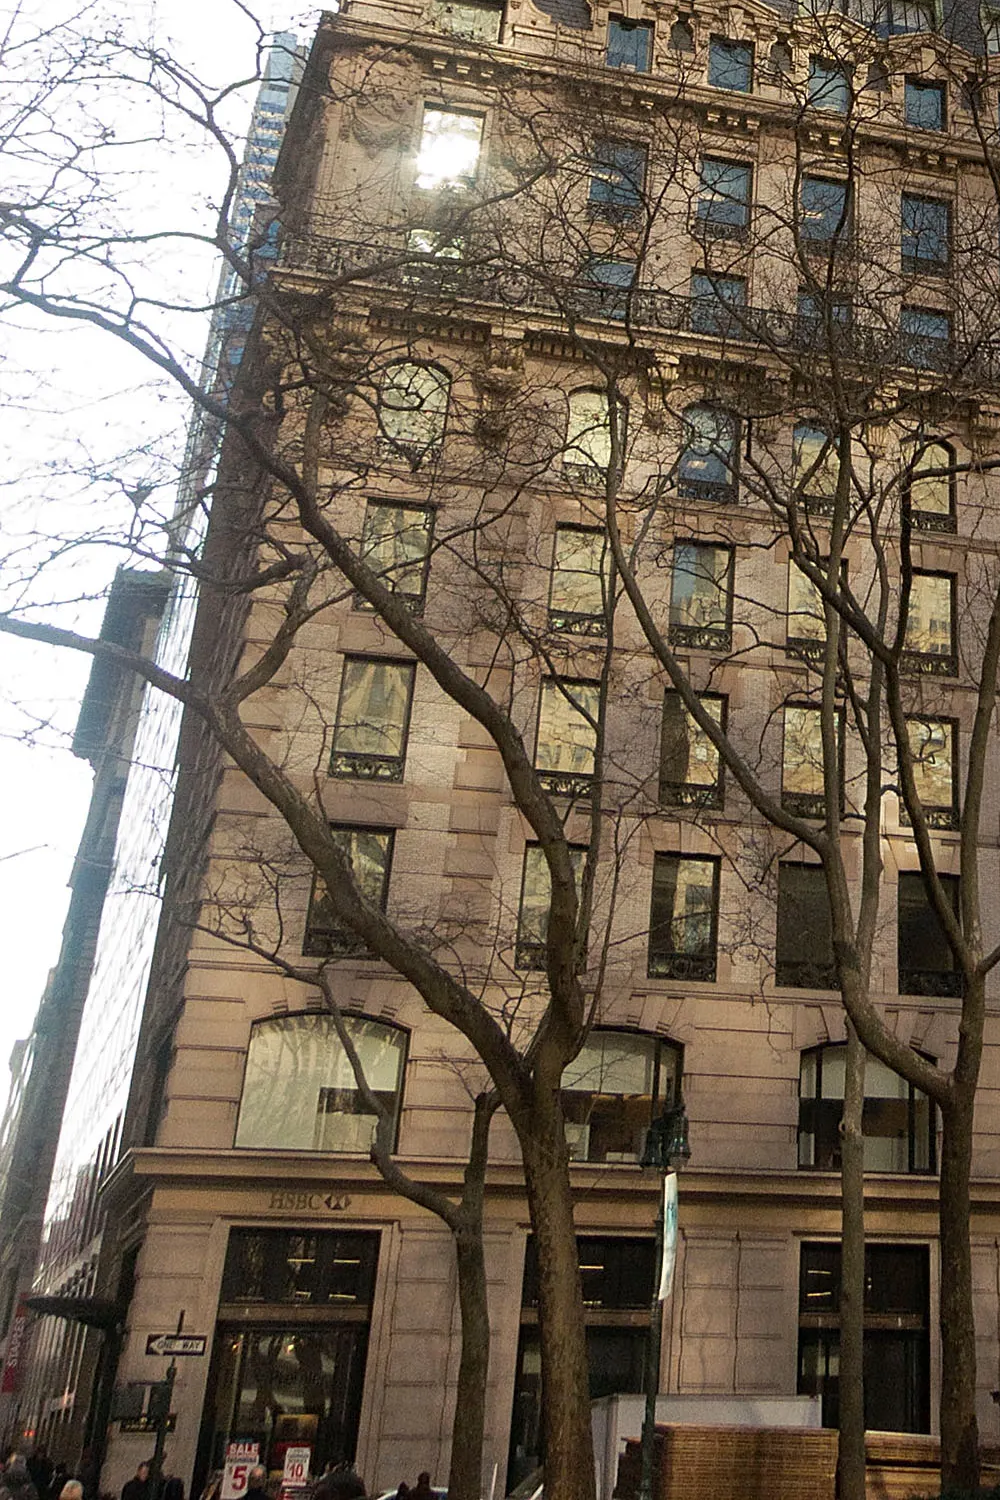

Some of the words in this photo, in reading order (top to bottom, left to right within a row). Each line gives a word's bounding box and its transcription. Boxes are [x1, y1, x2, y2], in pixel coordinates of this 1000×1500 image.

[269, 1193, 321, 1210] HSBC
[7, 1316, 27, 1367] STAPLES
[157, 1340, 173, 1350] ONE
[182, 1341, 200, 1350] WAY
[229, 1443, 259, 1454] SALE
